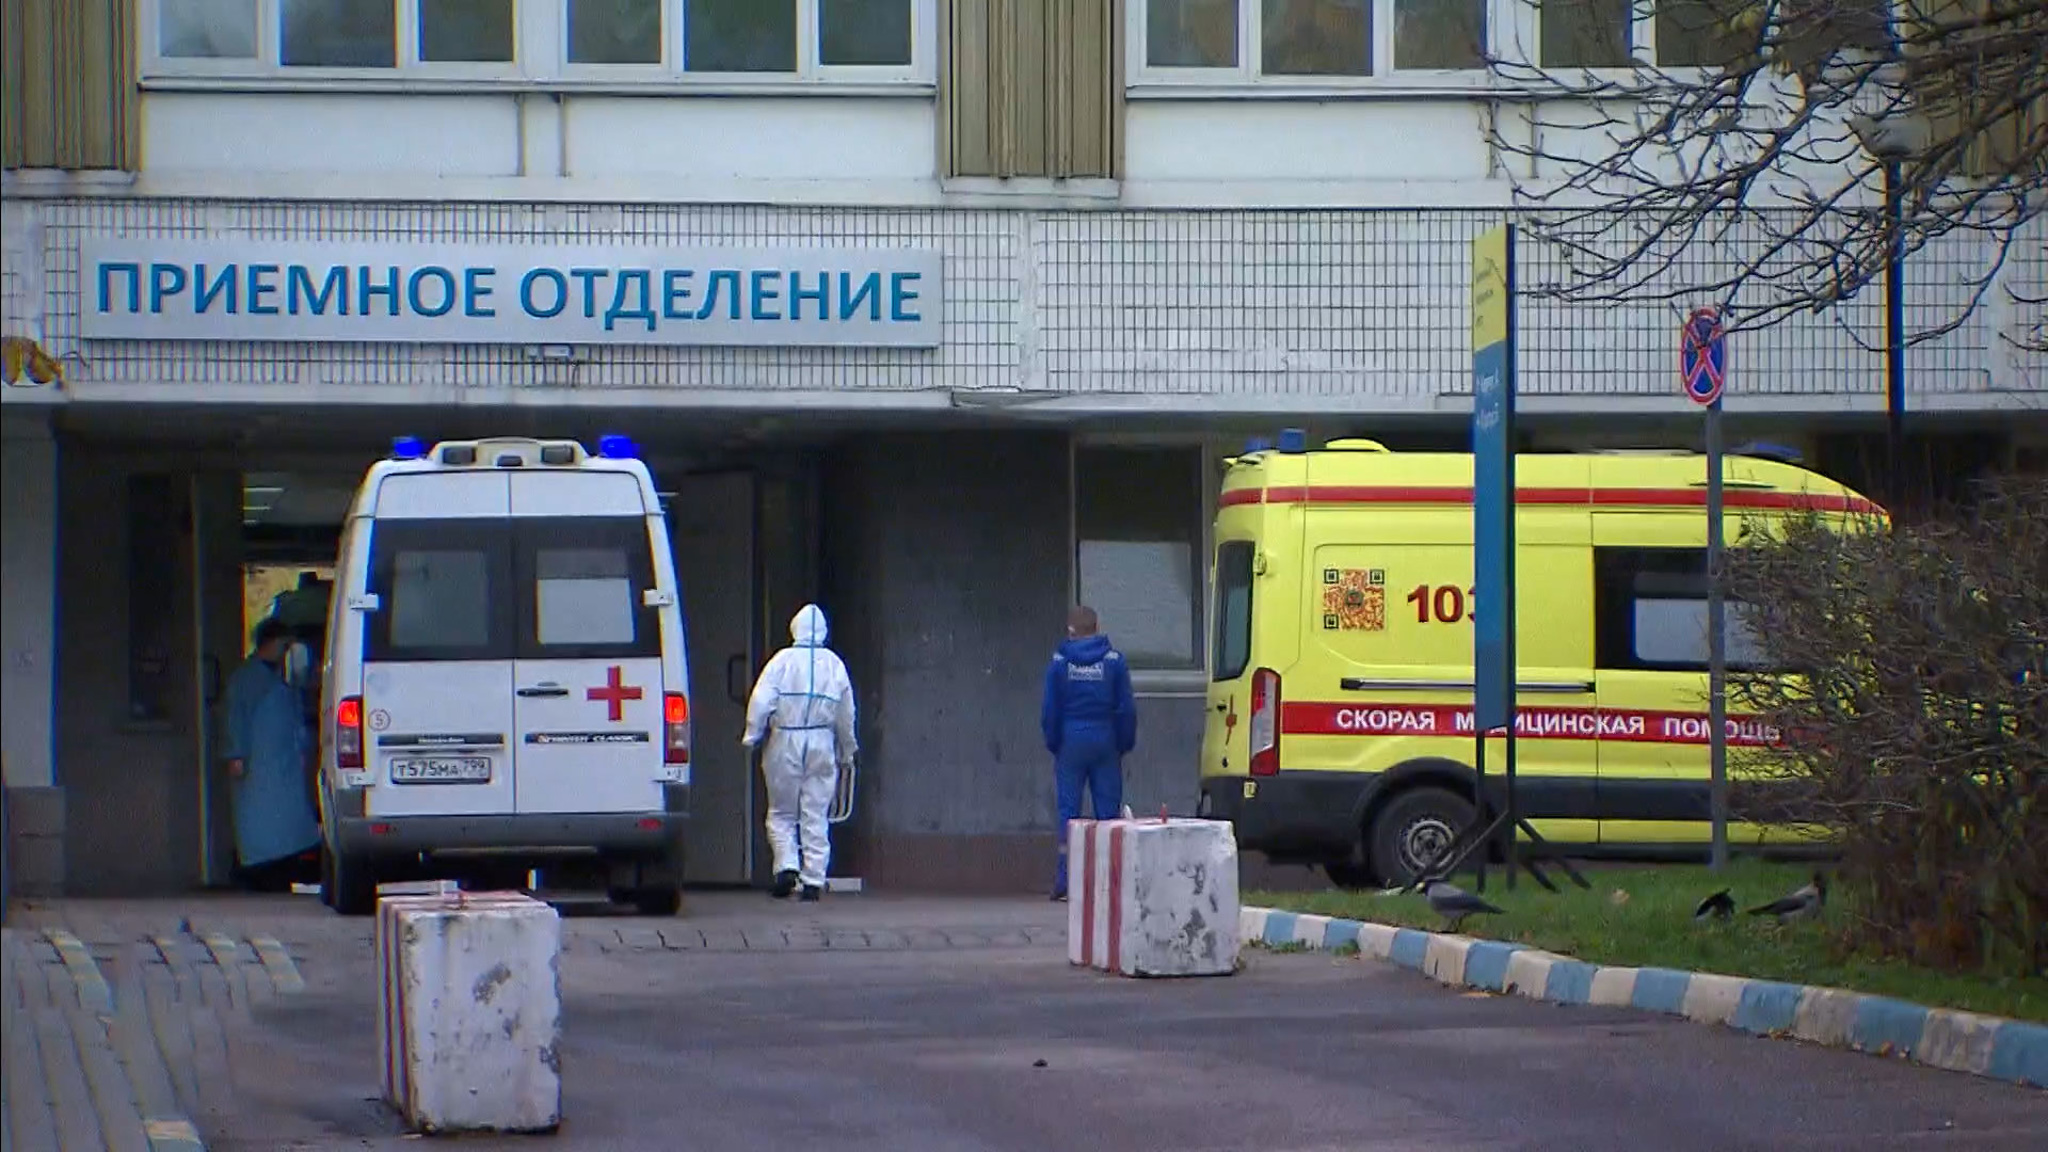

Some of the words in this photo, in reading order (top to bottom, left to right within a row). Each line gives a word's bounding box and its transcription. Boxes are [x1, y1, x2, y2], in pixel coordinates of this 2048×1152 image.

[97, 262, 498, 317] ПРИЕМНОЕ
[517, 266, 922, 332] ОТДЕЛЕНИЕ
[1407, 584, 1476, 623] 10
[1336, 709, 1436, 731] СКОРАЯ
